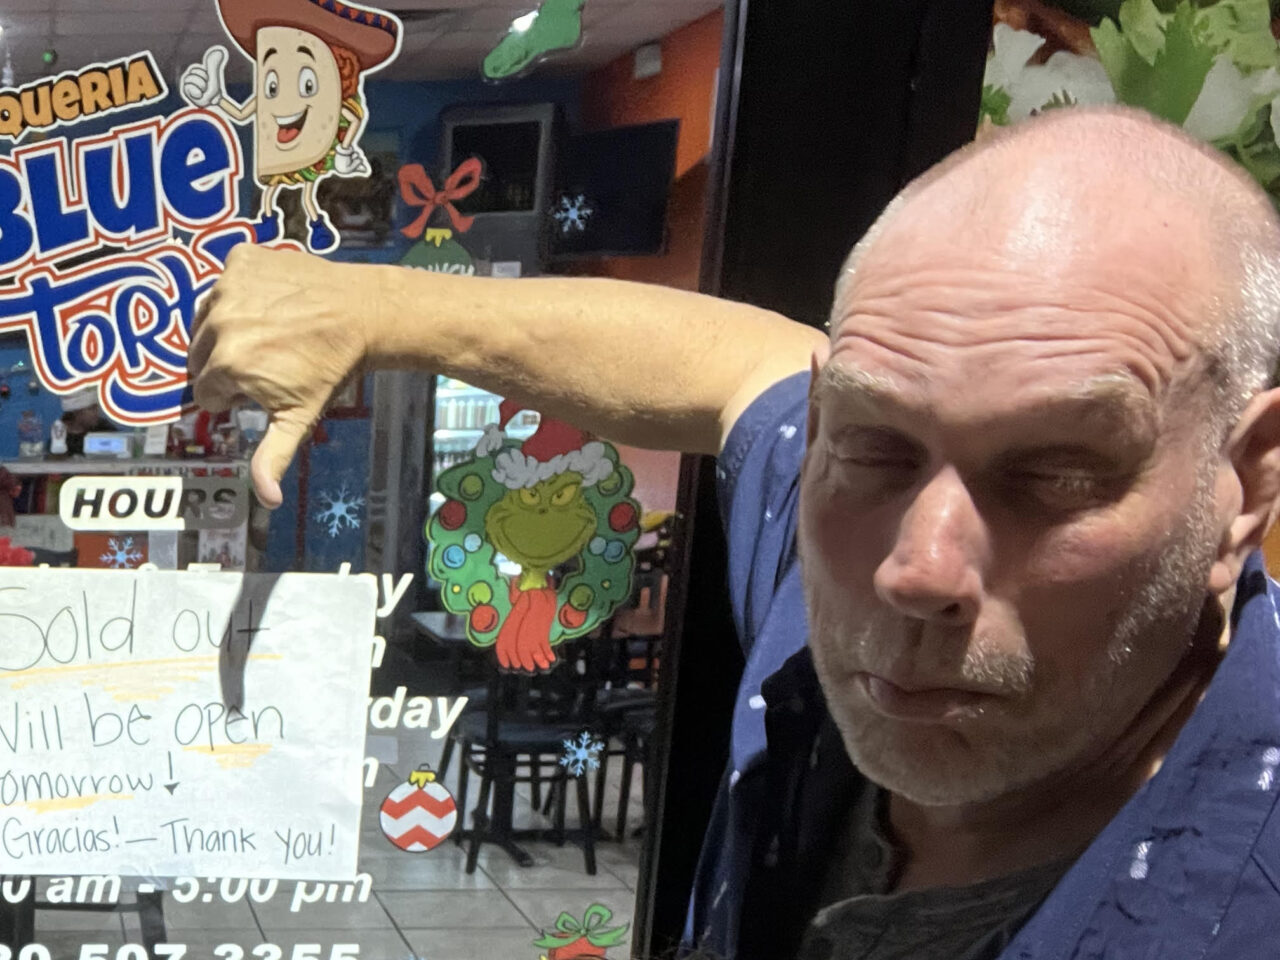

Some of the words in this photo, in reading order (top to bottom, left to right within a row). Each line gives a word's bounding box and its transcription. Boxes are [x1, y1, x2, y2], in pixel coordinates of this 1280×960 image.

[71, 488, 238, 520] HOURS
[172, 599, 271, 653] out
[83, 692, 153, 747] be
[174, 702, 284, 752] open
[160, 818, 257, 855] Thank
[275, 823, 336, 865] you!
[46, 873, 122, 904] am
[289, 872, 374, 913] pm
